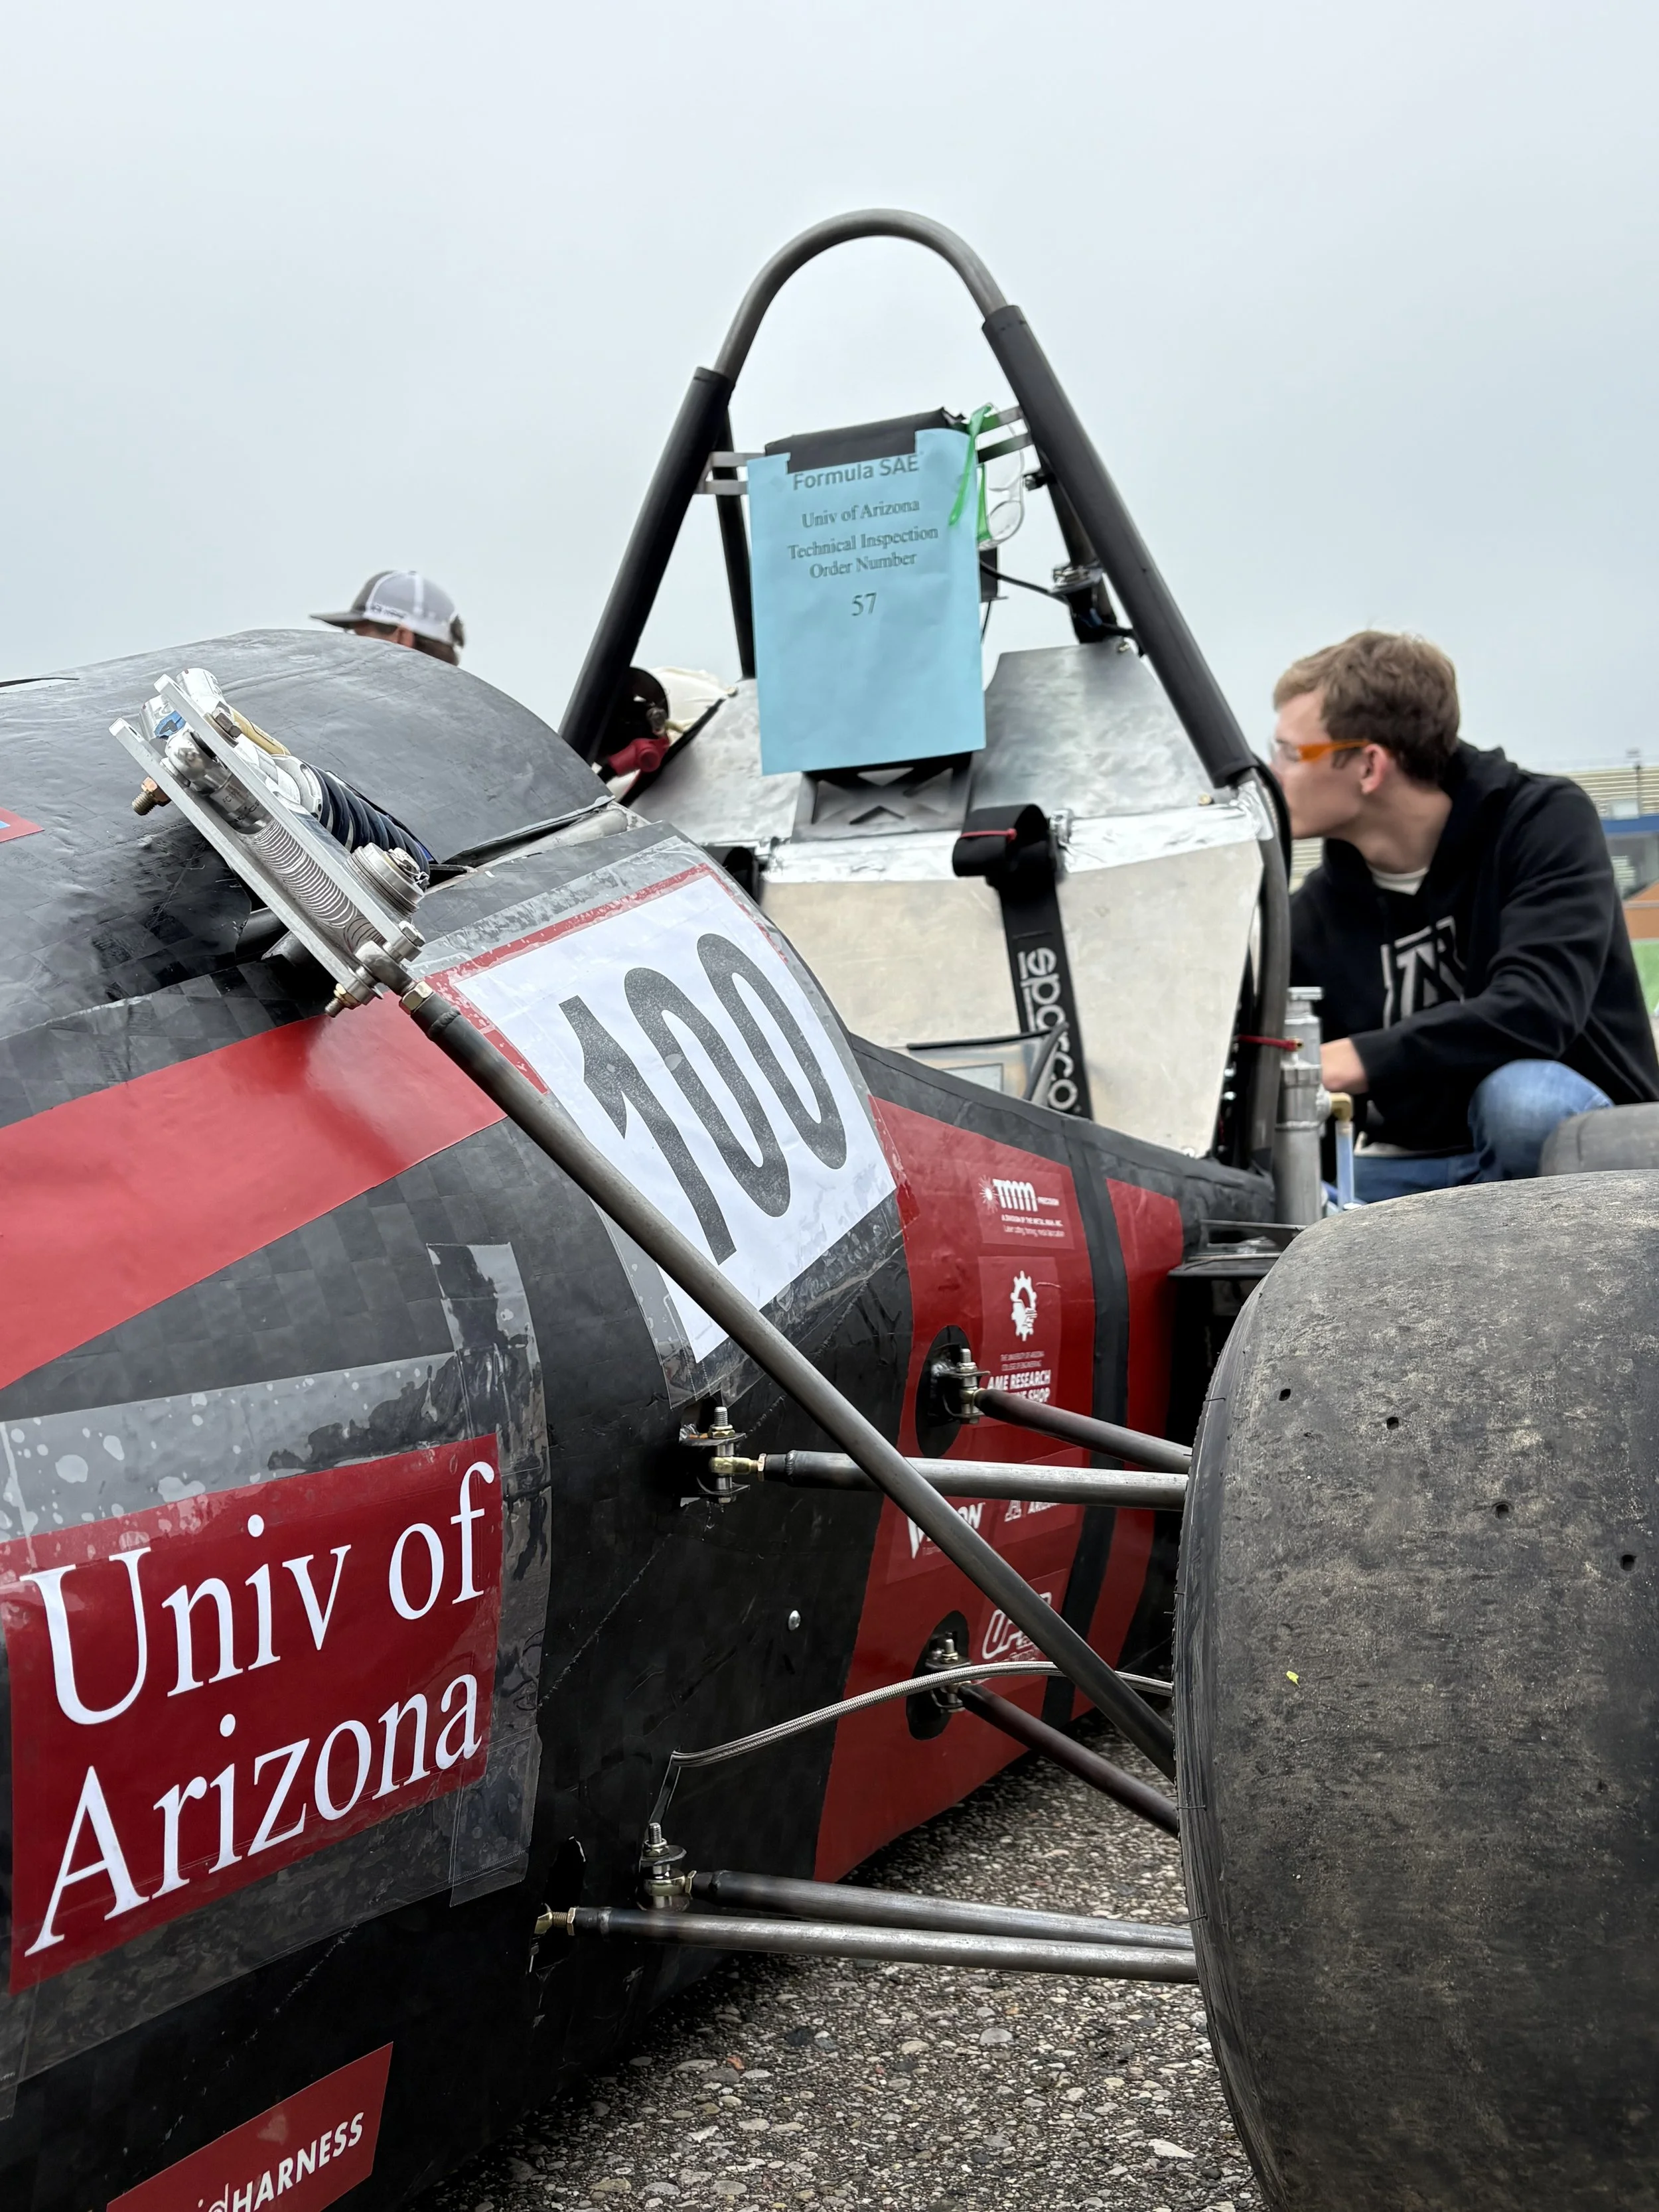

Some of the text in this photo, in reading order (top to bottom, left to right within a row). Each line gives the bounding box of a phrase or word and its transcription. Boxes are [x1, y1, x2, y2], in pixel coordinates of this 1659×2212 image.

[793, 455, 920, 490] Formula SAE
[802, 500, 920, 528] Univ of Arizona
[788, 526, 939, 559] Technical Inspection
[810, 552, 917, 579] Order Number
[851, 592, 877, 617] 57
[559, 933, 847, 1266] 100
[1010, 1369, 1051, 1390] RESEARCH
[20, 1461, 495, 1726] Univ of
[24, 1672, 482, 1958] Arizona
